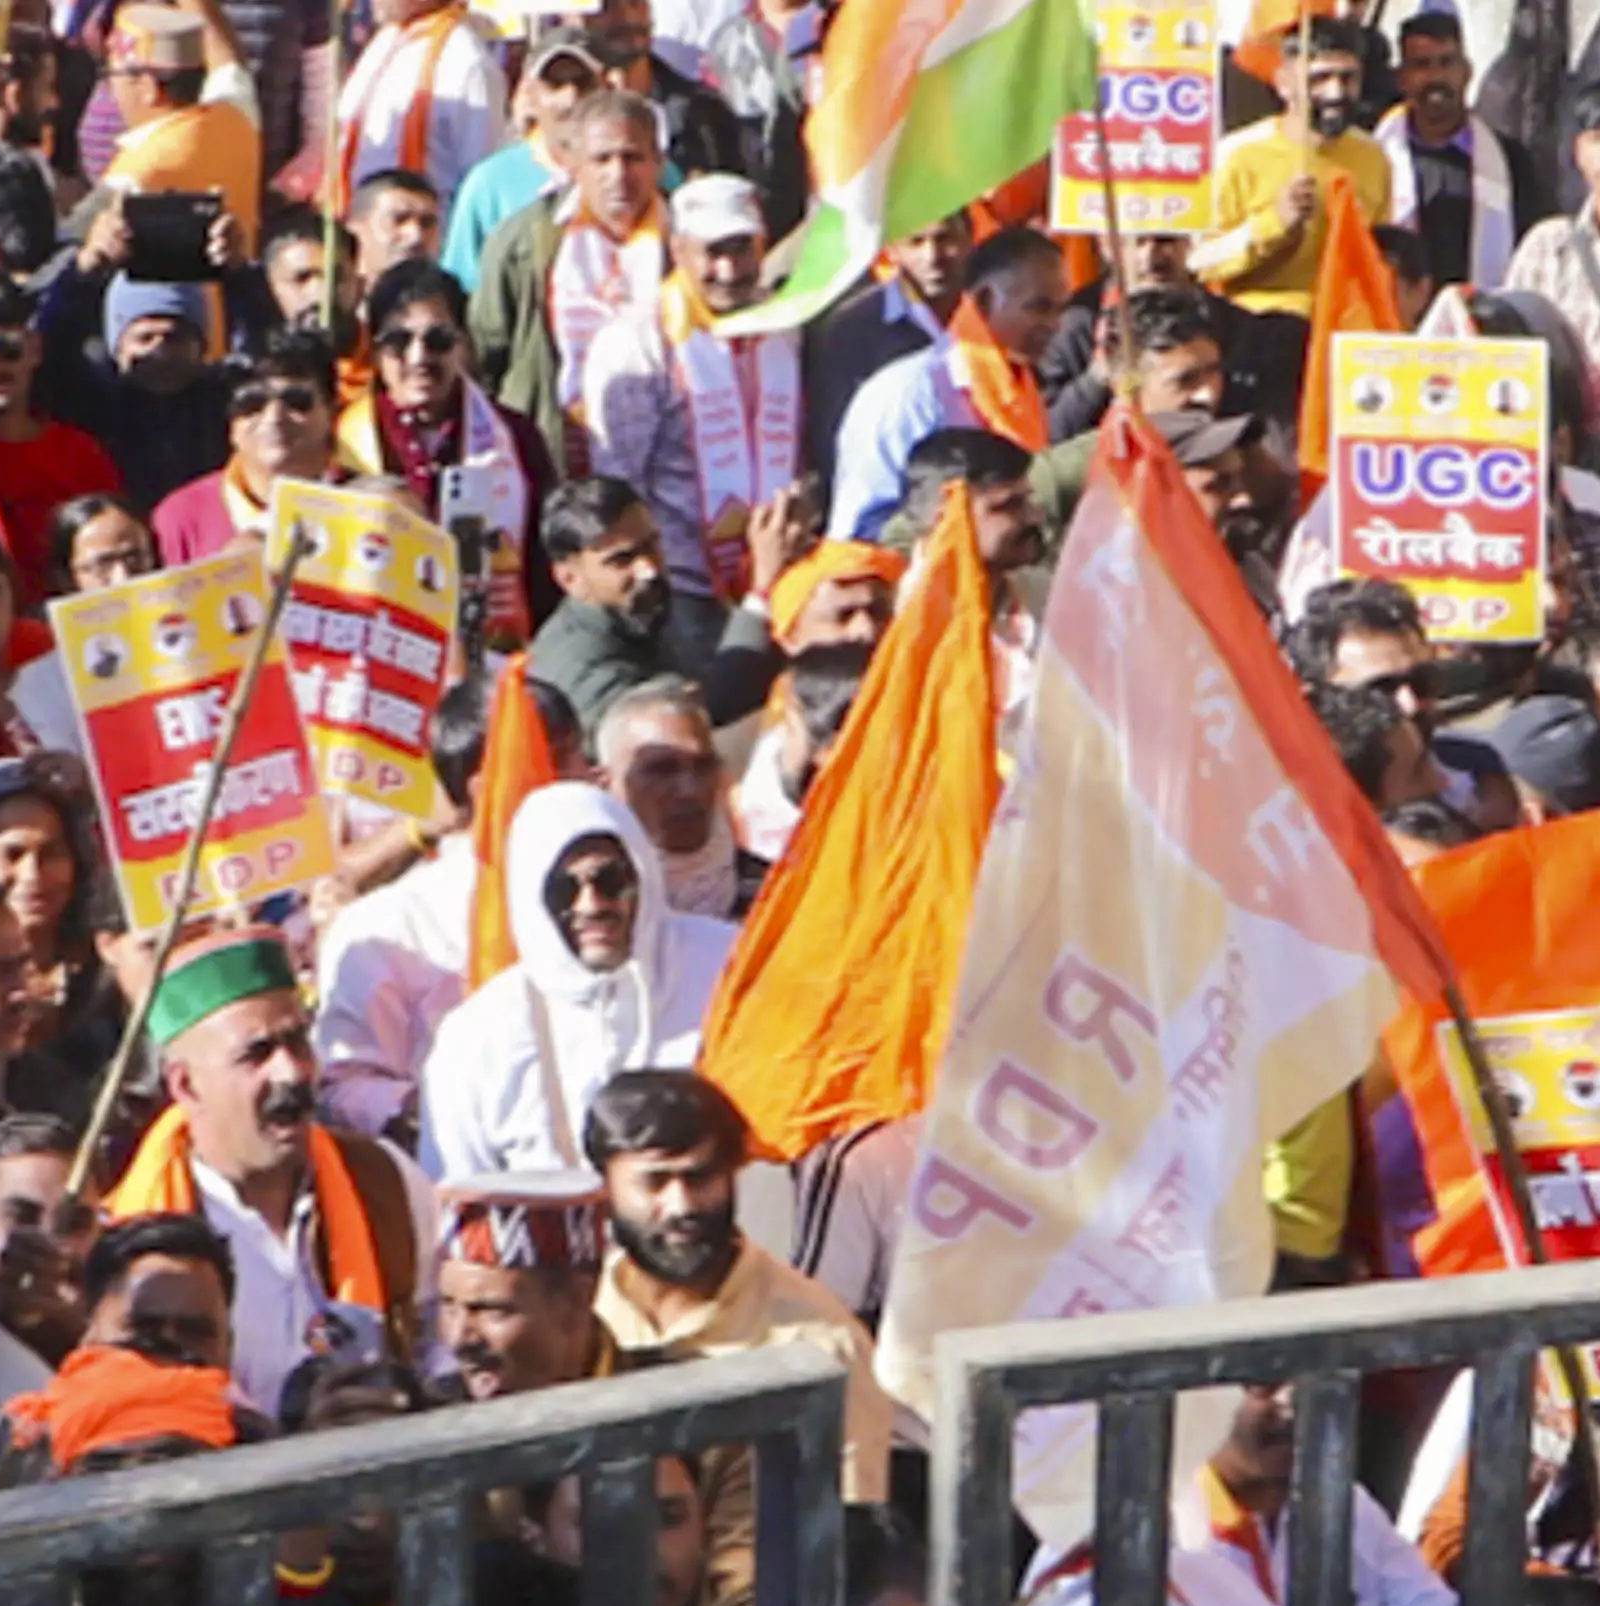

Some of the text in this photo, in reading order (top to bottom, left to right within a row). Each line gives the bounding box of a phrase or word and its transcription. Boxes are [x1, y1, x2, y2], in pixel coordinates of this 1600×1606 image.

[1097, 75, 1201, 118] GC
[1355, 446, 1523, 499] UGC
[1353, 513, 1525, 570] रोलबैक
